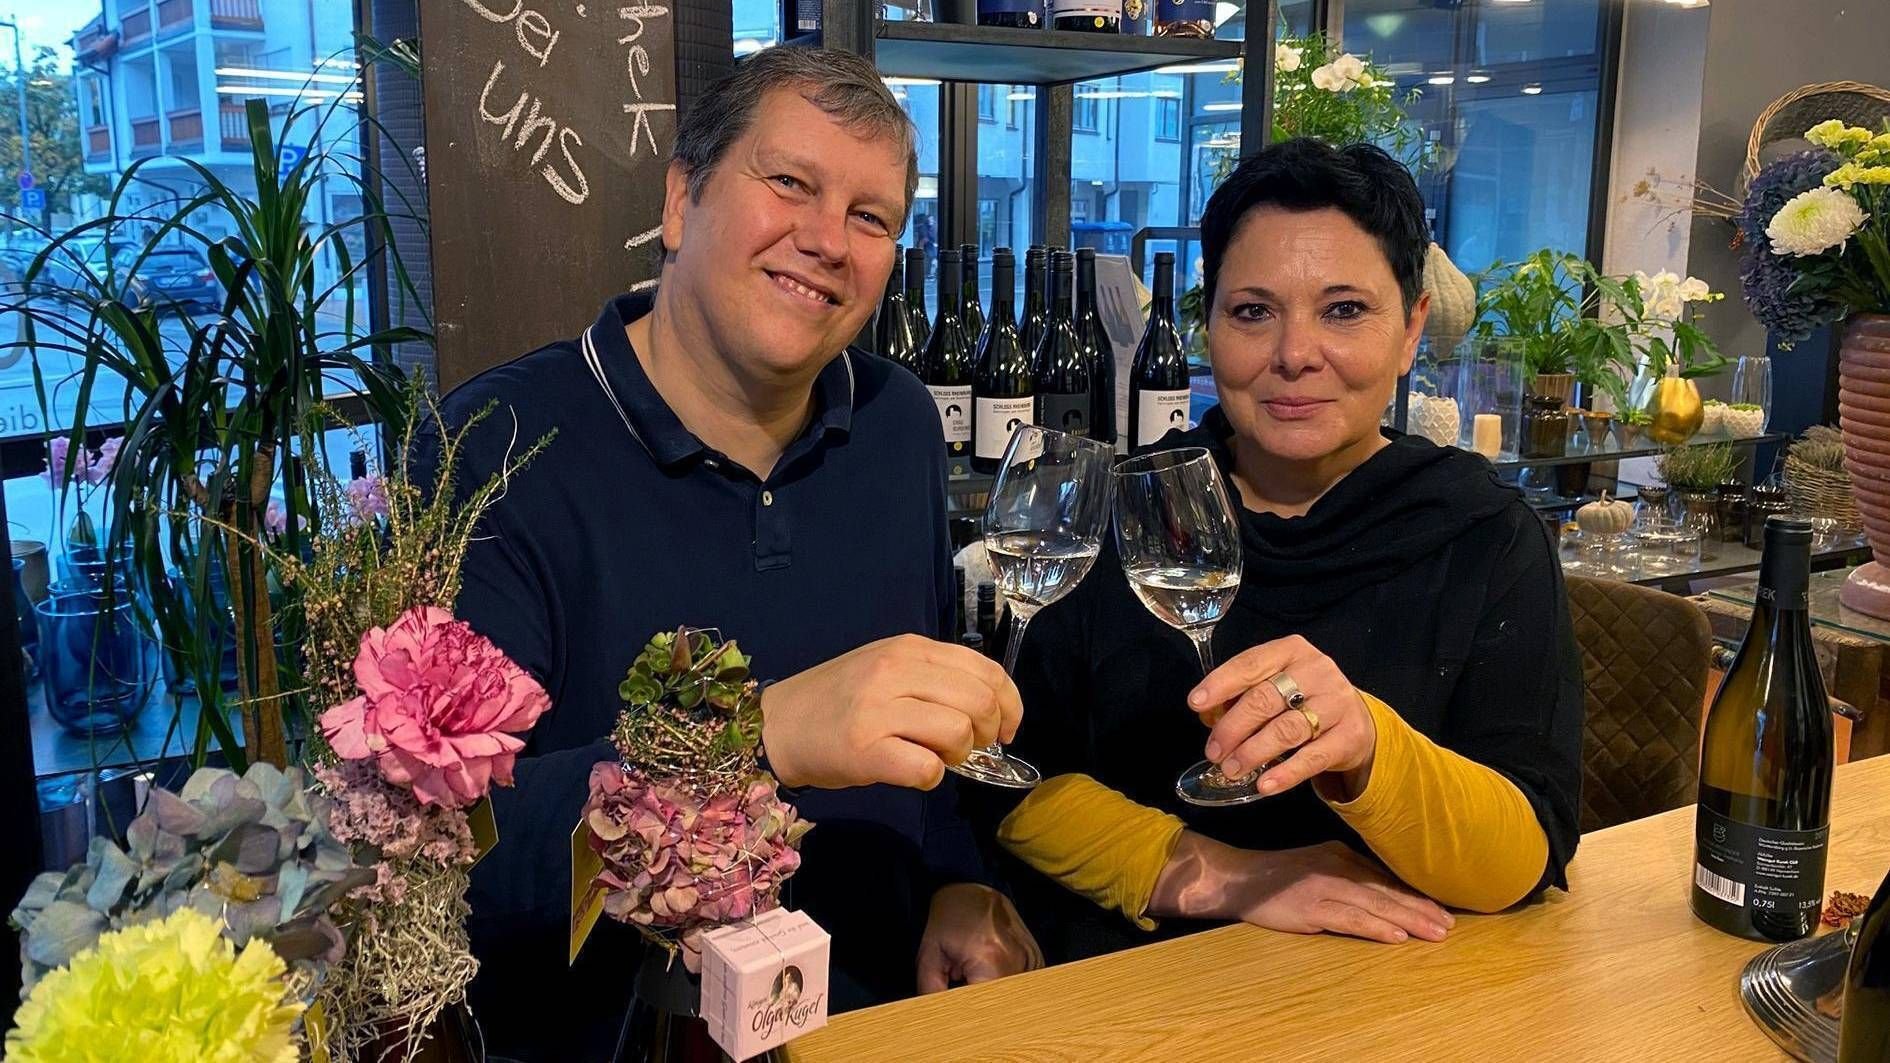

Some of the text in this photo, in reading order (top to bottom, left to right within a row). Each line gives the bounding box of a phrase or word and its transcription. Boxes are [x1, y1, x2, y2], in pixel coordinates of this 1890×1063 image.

[617, 0, 677, 156] hek
[479, 60, 590, 205] uns
[278, 148, 299, 172] P
[27, 191, 40, 206] P
[1752, 898, 1775, 909] 0,75l
[751, 1003, 783, 1040] Olga
